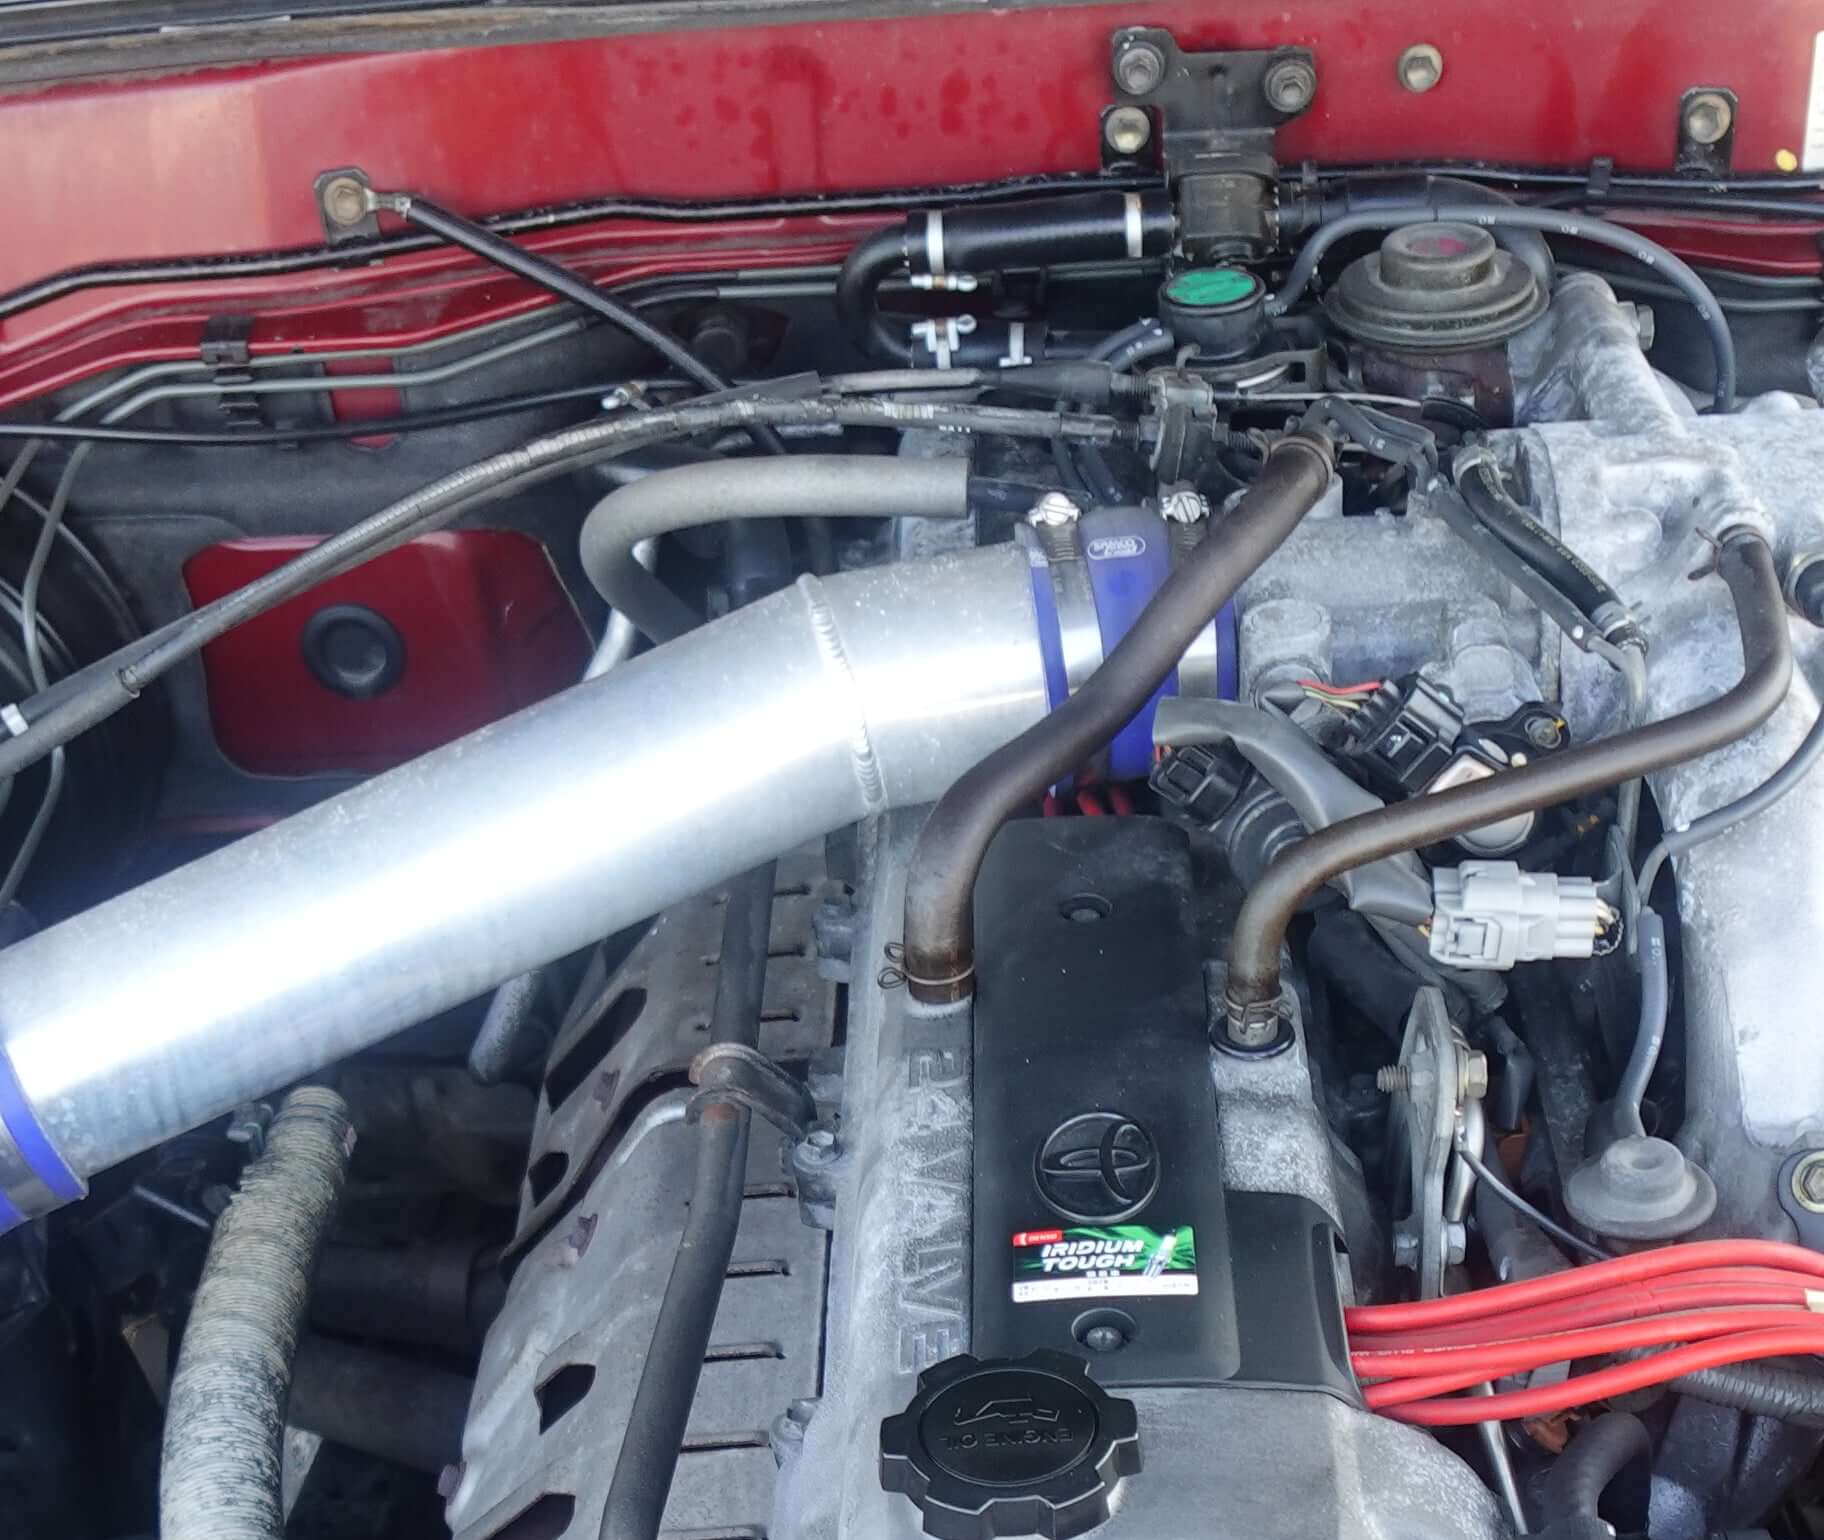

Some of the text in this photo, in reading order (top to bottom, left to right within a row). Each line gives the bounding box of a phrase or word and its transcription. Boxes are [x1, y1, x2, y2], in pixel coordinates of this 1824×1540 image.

[1041, 1238, 1145, 1259] IRIDIUM
[1041, 1253, 1136, 1273] TOUGH
[936, 1426, 1074, 1450] ENGINE OIL
